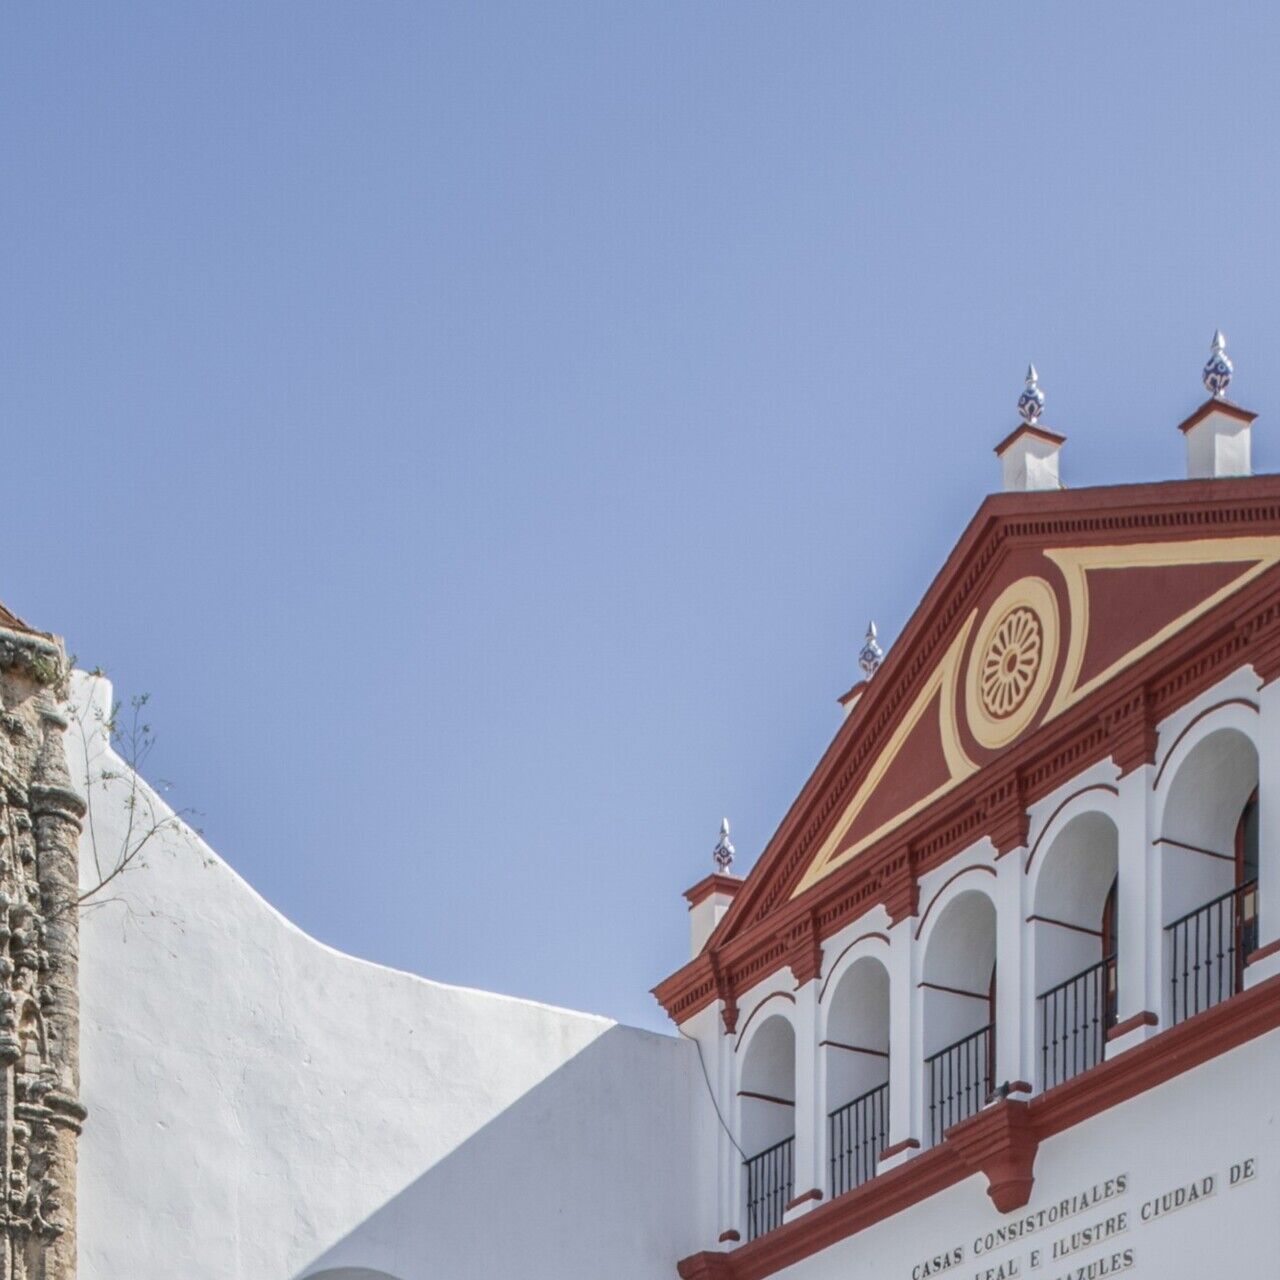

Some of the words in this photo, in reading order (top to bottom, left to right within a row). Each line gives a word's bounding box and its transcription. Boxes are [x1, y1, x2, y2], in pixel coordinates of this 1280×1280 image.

[973, 1174, 1127, 1255] CONSISTORIALES
[1030, 1250, 1040, 1268] E
[1052, 1212, 1128, 1259] ILUSTRE
[1140, 1176, 1214, 1221] CIUDAD
[1229, 1158, 1255, 1185] DE
